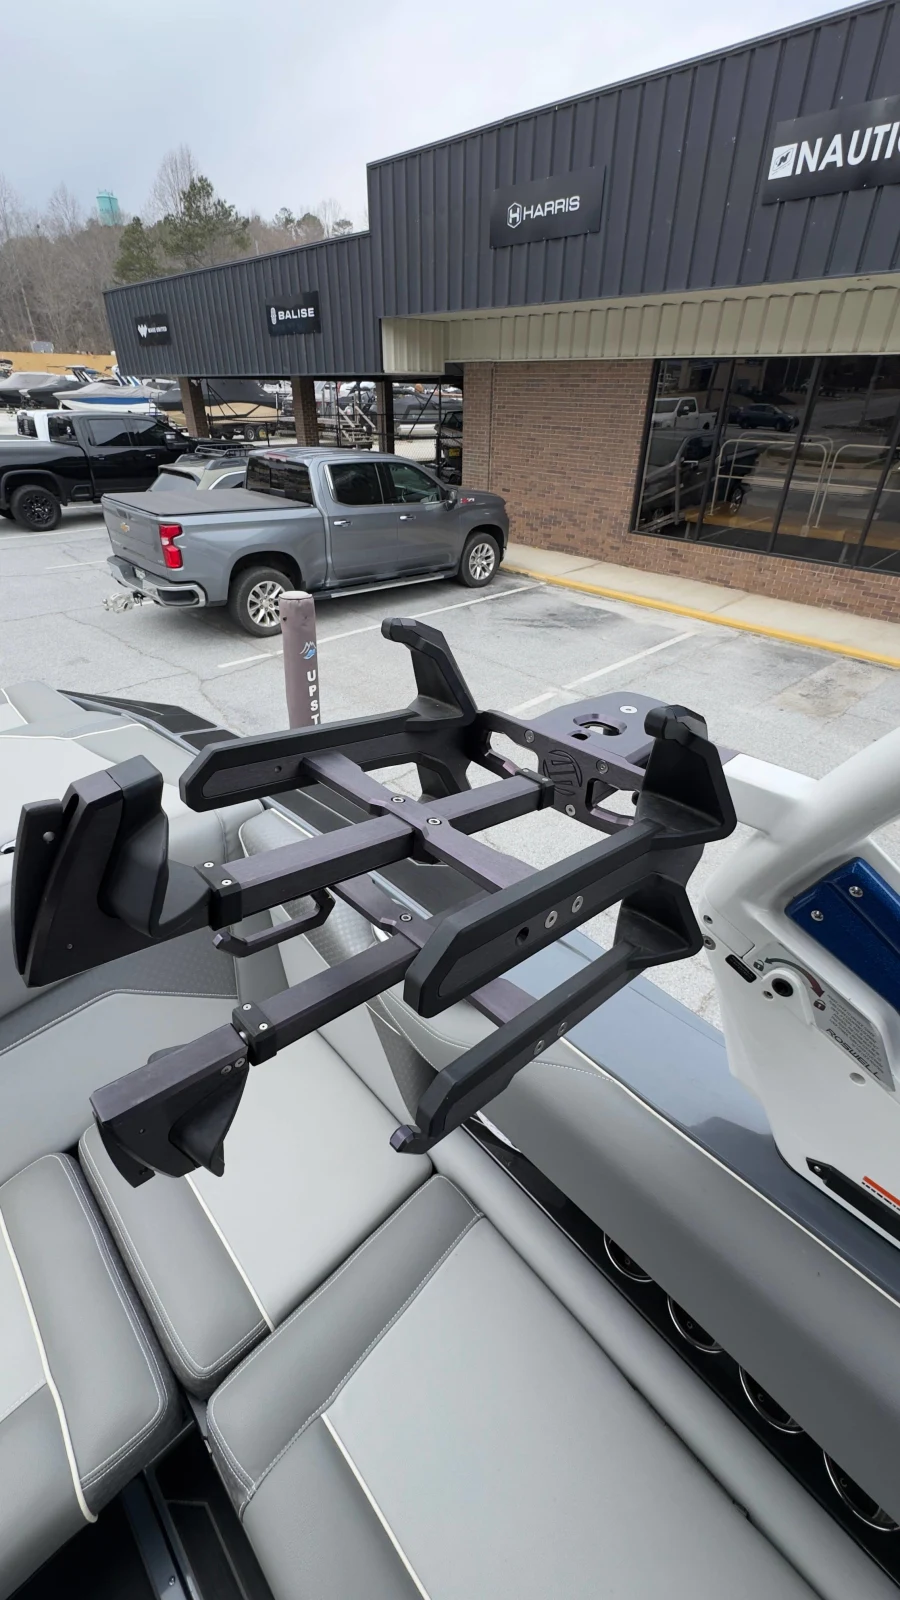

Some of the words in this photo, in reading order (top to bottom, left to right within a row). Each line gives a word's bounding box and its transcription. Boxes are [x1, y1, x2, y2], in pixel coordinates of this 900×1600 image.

[795, 121, 900, 176] NAUTI
[523, 195, 580, 220] HARRIS
[278, 307, 315, 321] BALISE
[825, 1028, 881, 1081] ROSWELL
